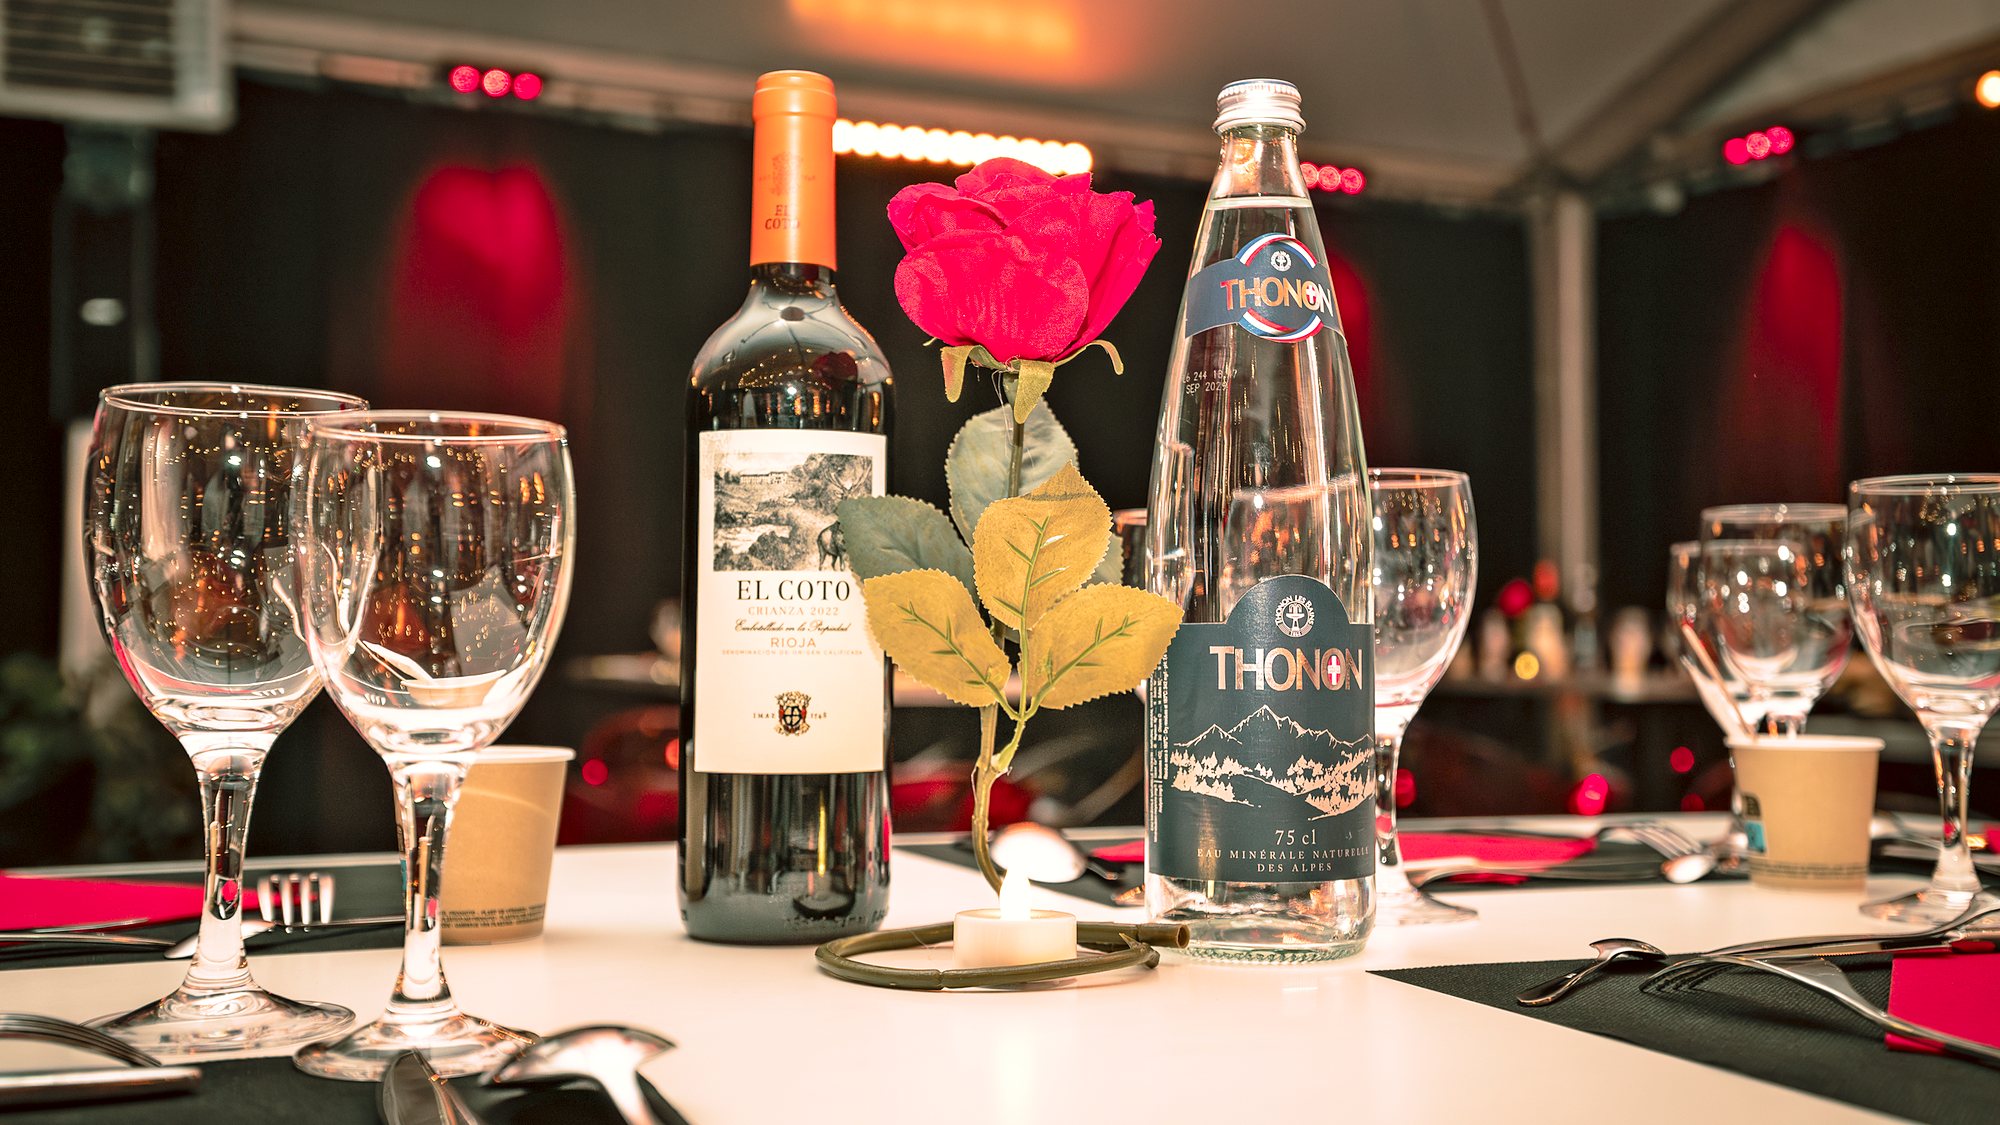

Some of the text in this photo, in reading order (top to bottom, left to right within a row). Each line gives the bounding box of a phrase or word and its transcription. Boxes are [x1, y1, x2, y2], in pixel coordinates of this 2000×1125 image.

[1220, 276, 1334, 317] THONON
[1185, 382, 1200, 396] SEP
[737, 579, 851, 602] EL COTO
[748, 606, 839, 616] CRIANZA 2022
[1274, 595, 1293, 627] THONON
[770, 636, 817, 649] RIOJA
[1209, 645, 1363, 692] THONON
[1275, 828, 1317, 846] 75 cl
[1197, 846, 1369, 860] EAU MINÉRALE NATURELLE
[1257, 862, 1332, 873] DES ALPES
